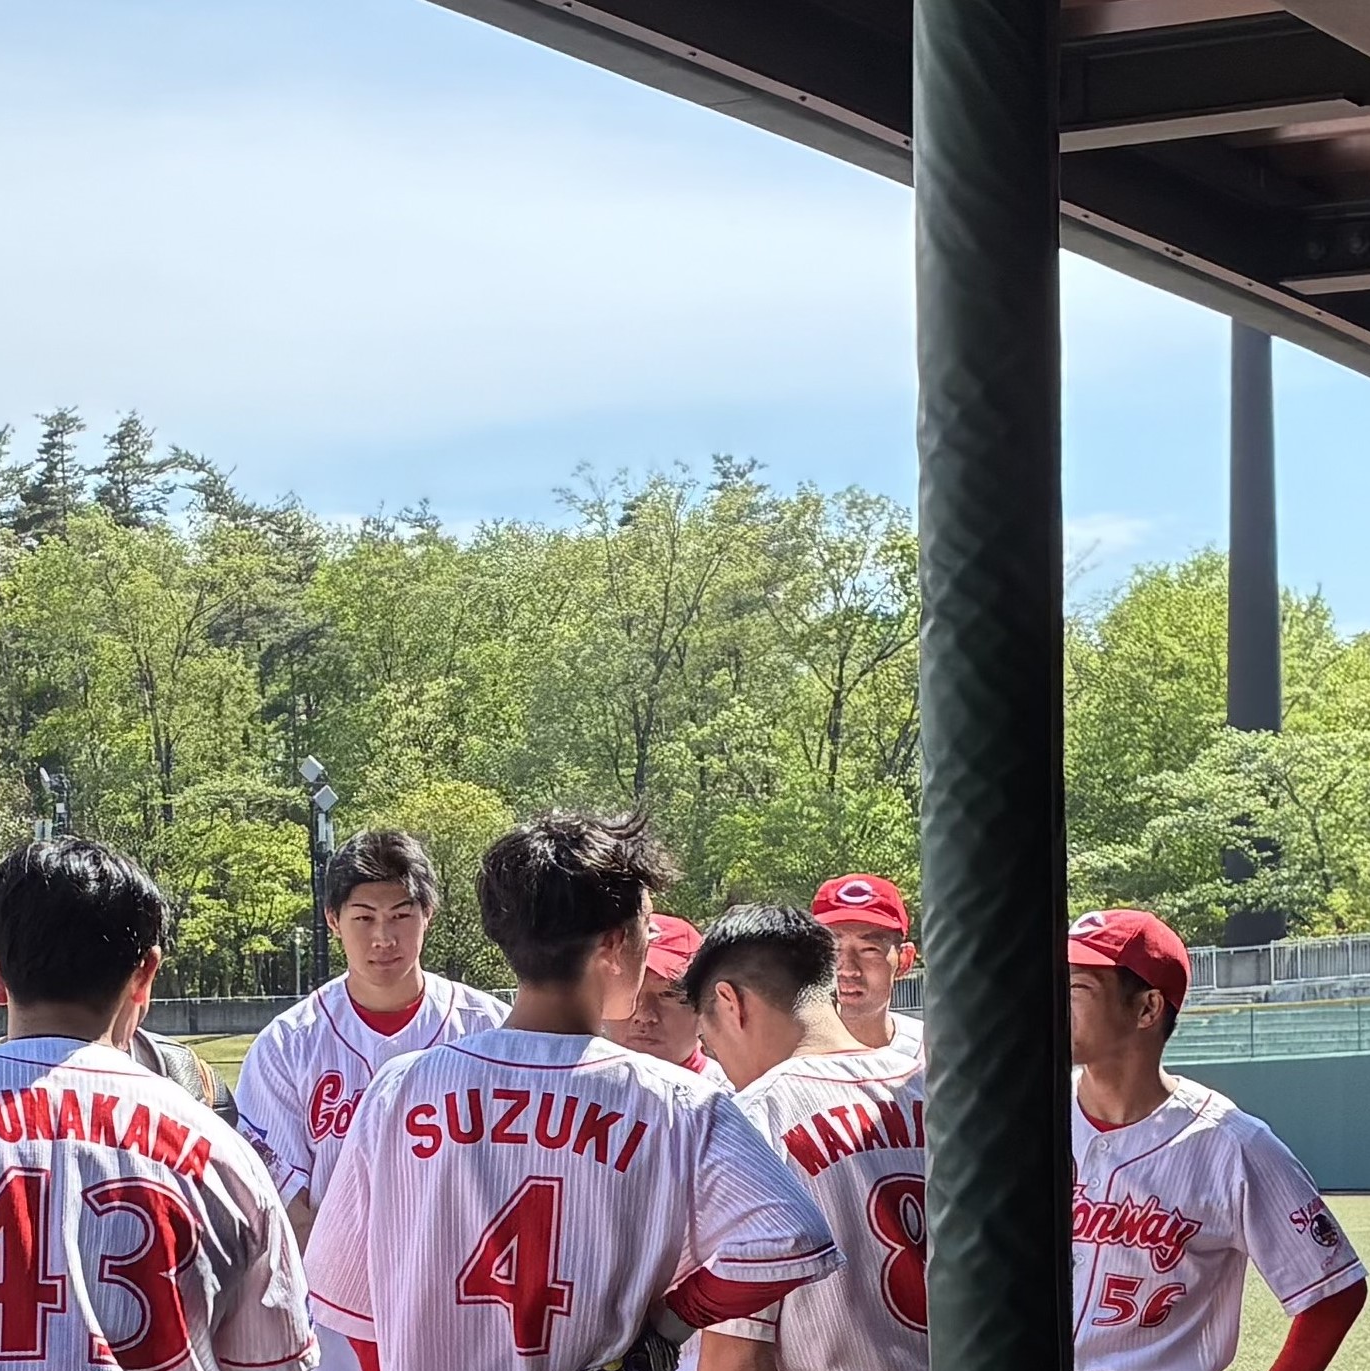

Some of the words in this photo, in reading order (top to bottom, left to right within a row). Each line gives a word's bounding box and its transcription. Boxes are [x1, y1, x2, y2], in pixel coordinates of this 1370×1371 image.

[405, 1087, 649, 1174] SUZUKI
[455, 1174, 575, 1358] 4
[1092, 1272, 1187, 1328] 56
